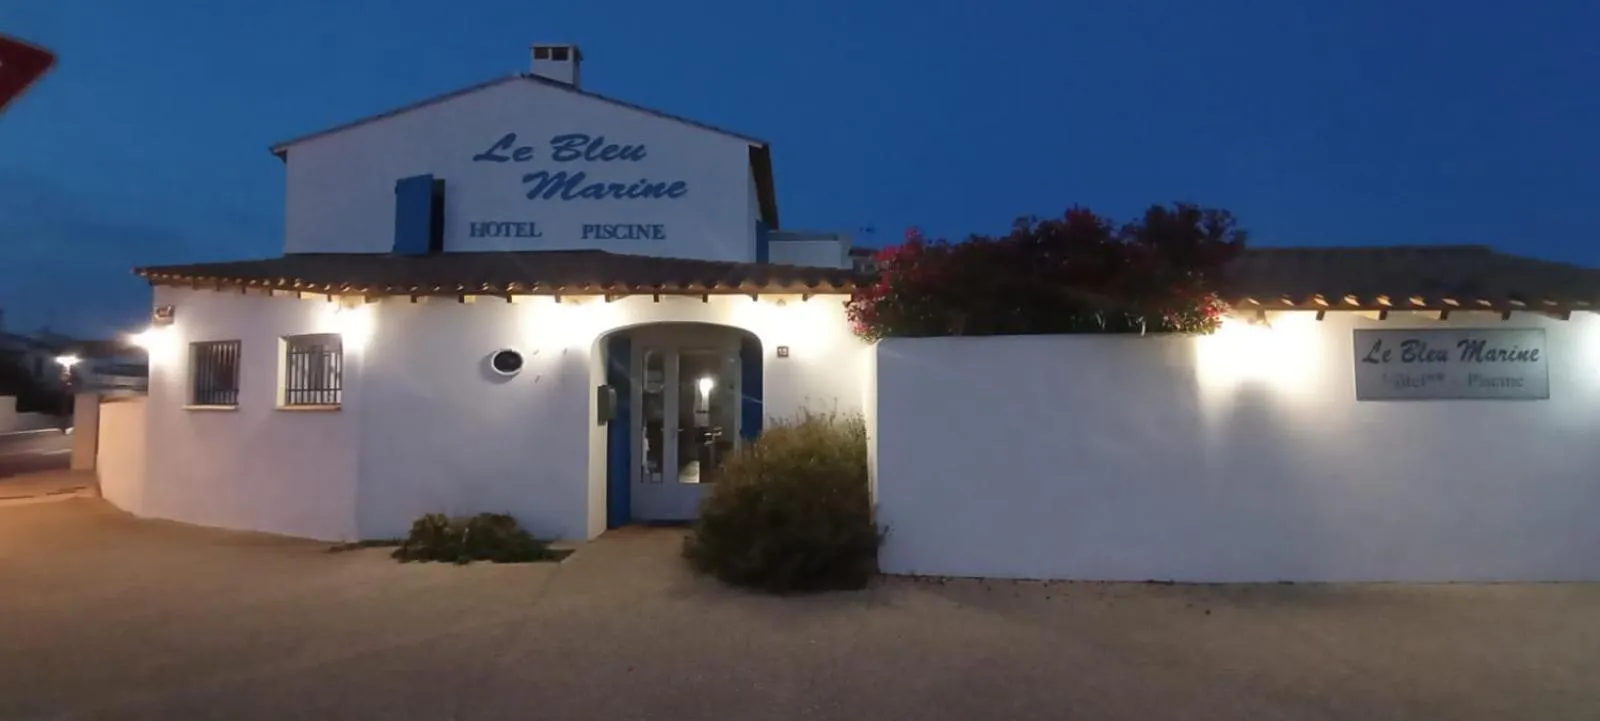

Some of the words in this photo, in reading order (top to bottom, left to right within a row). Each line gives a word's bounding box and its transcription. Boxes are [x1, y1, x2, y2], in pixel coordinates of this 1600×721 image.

[472, 132, 534, 163] Le
[550, 133, 647, 163] Bleu
[522, 170, 688, 201] Marine
[469, 221, 543, 238] HOTEL
[581, 223, 666, 240] PISCINE
[1362, 338, 1392, 364] Le
[1401, 339, 1449, 363] Bleu
[1457, 339, 1540, 363] Marine
